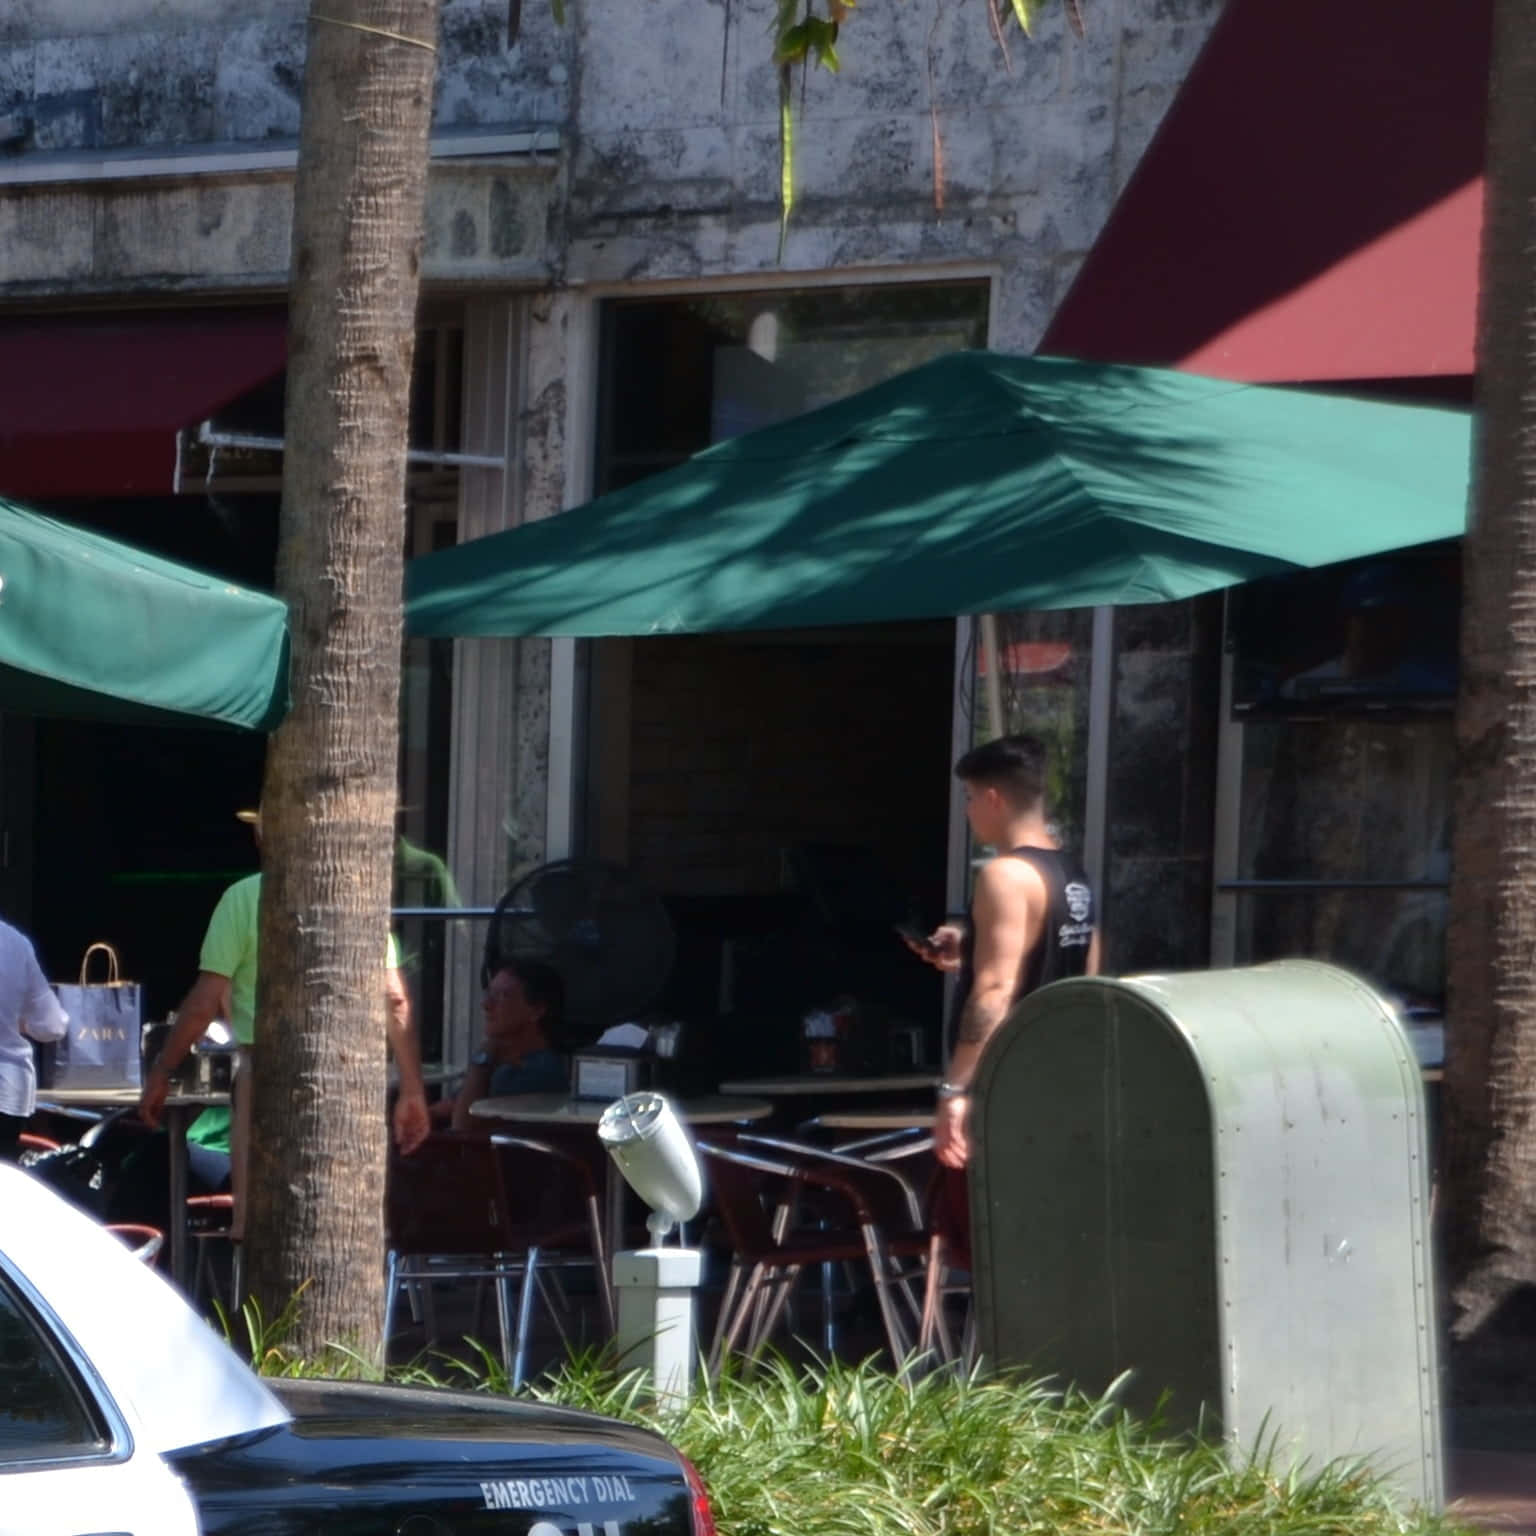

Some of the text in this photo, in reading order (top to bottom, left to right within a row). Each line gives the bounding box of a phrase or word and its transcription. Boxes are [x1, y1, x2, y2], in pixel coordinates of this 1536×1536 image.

[77, 1028, 126, 1041] ZARA
[480, 1473, 635, 1510] EMERGENCY DIAL
